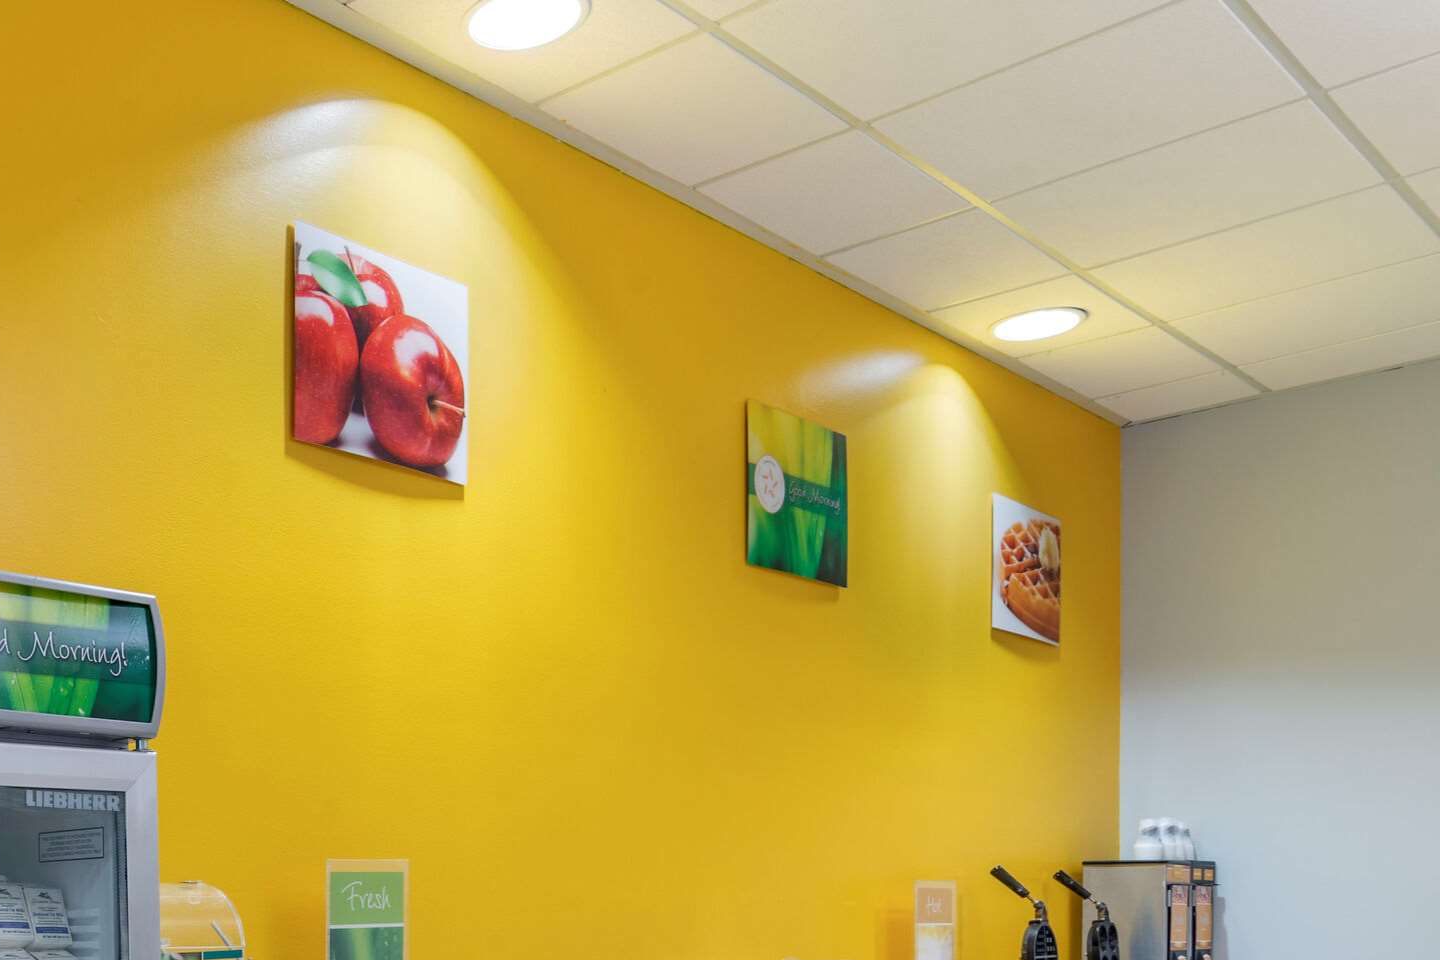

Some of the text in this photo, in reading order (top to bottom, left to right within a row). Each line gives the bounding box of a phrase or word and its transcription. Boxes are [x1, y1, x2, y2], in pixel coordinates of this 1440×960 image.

[17, 630, 128, 676] Morning!
[25, 788, 121, 812] LIEBHERR
[342, 880, 392, 912] Fresh
